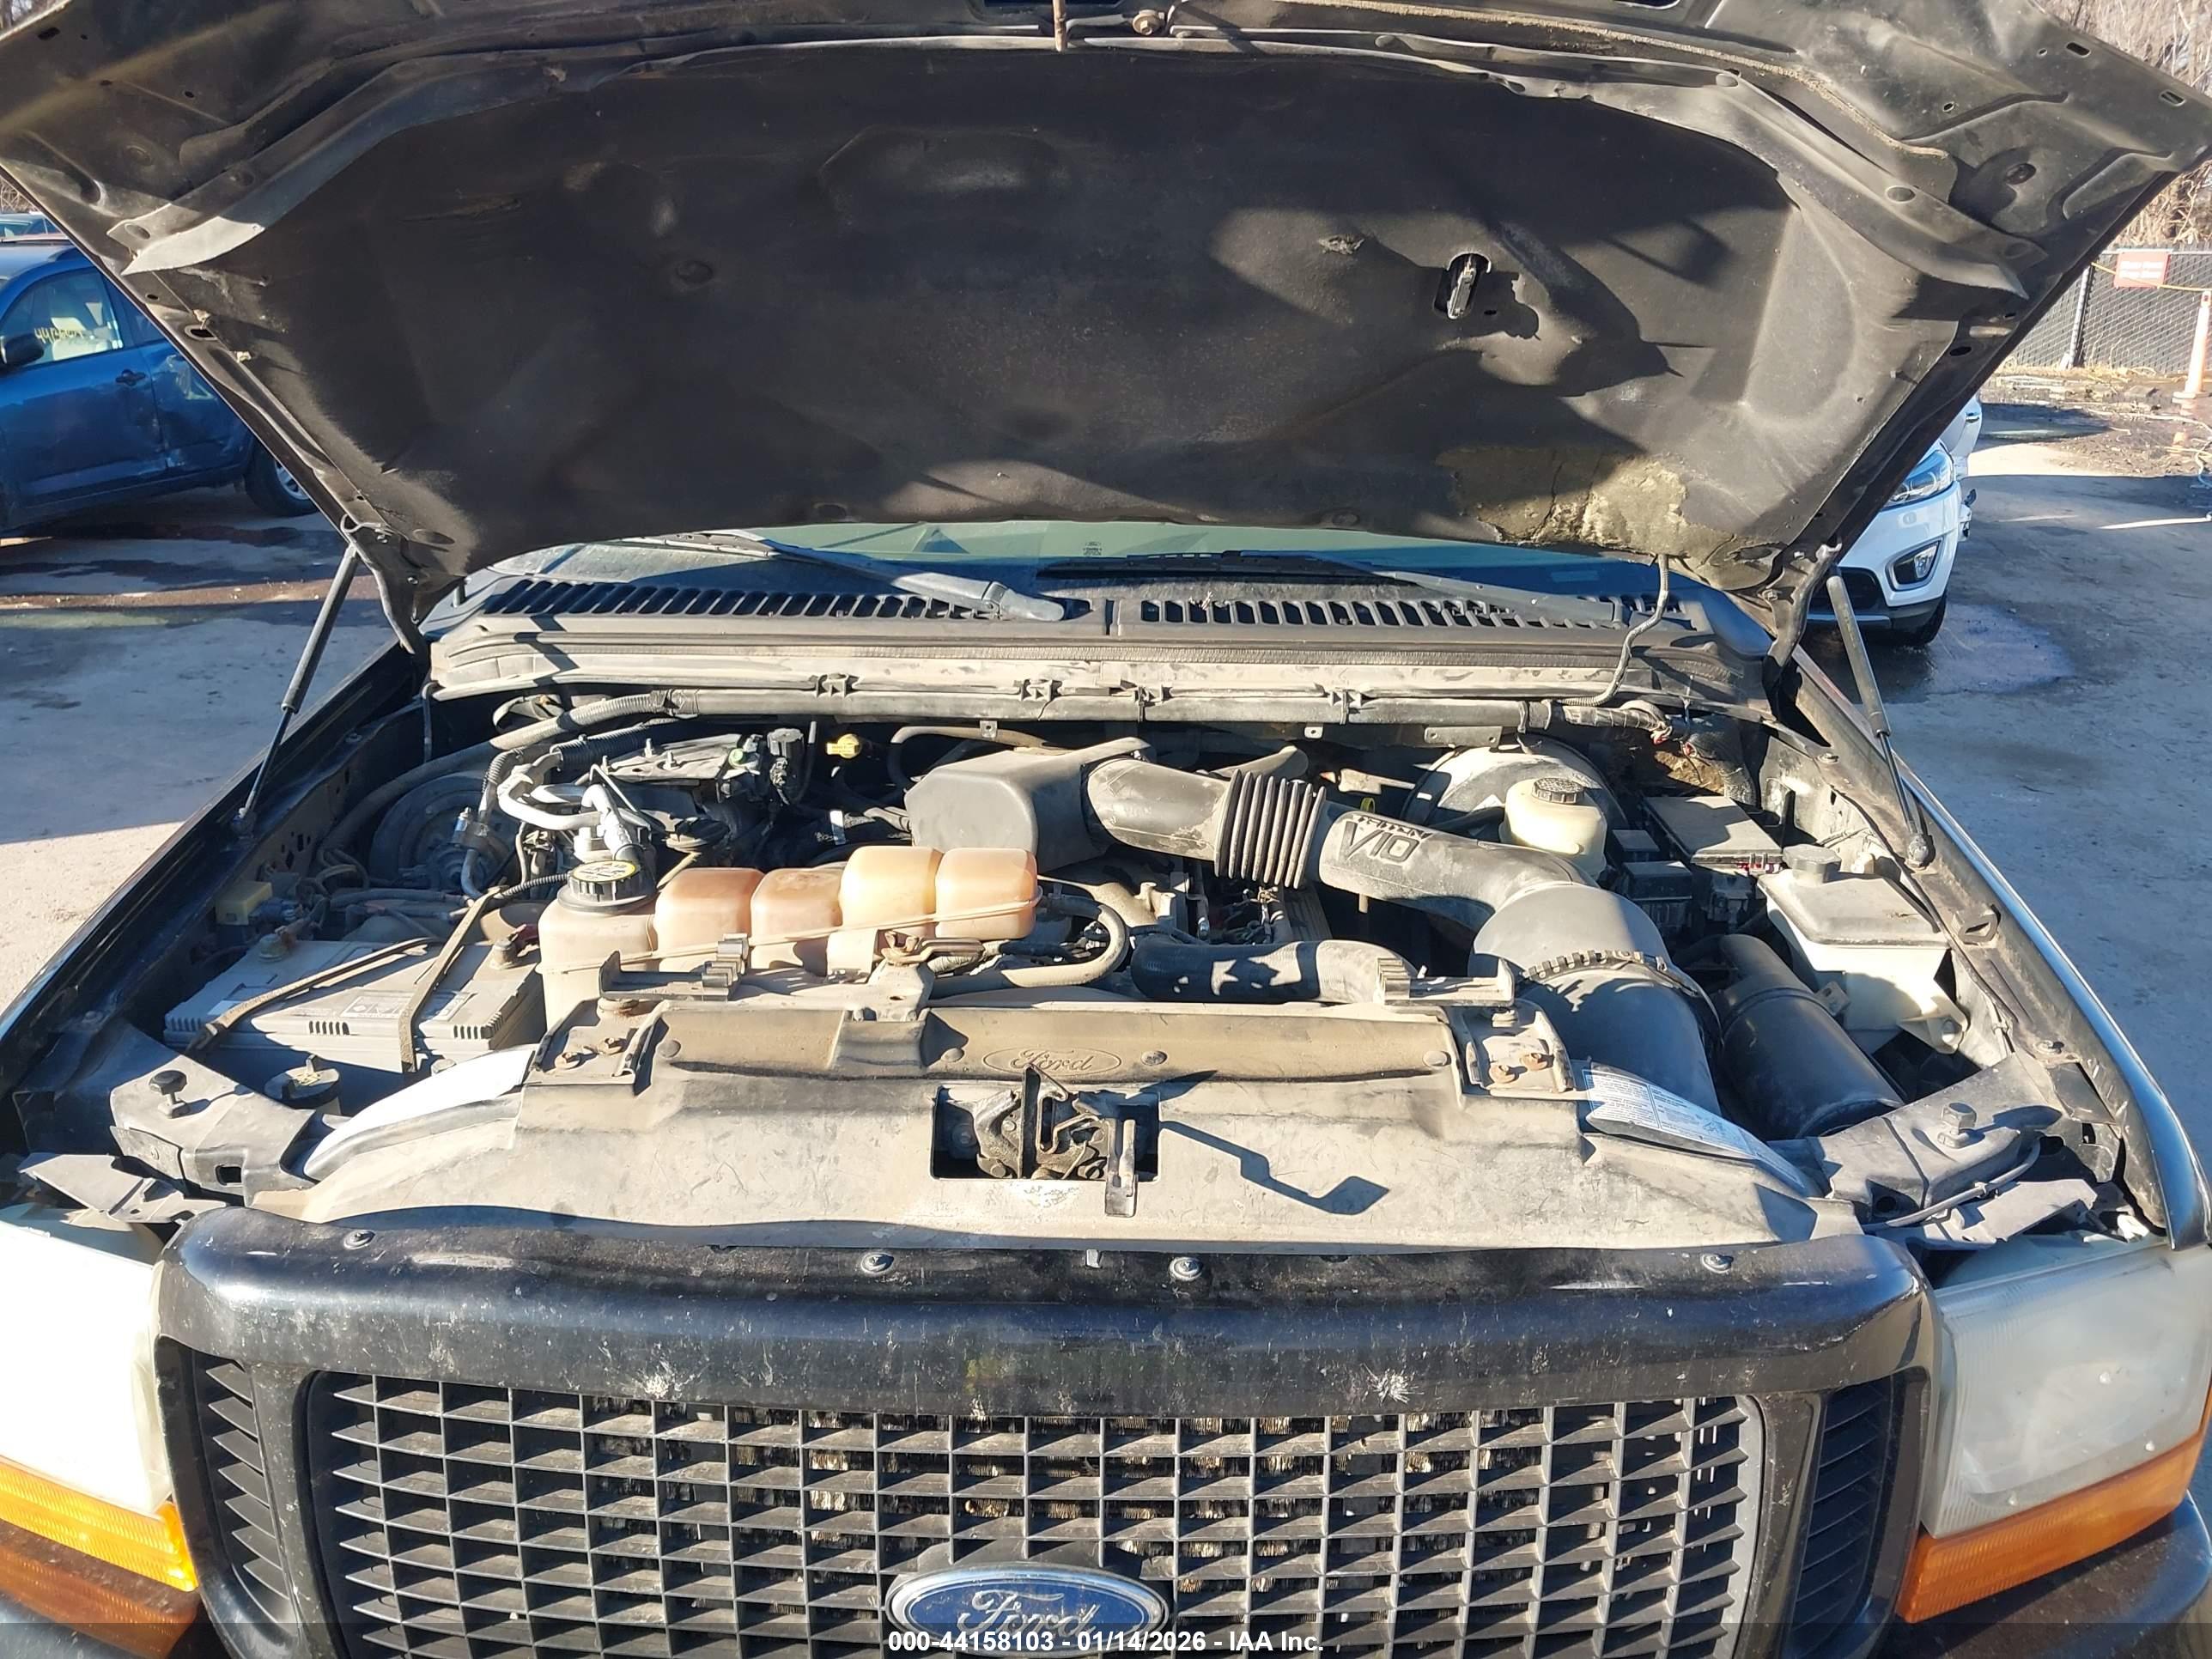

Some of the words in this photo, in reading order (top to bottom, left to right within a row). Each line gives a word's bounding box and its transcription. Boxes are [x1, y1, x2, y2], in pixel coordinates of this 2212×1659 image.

[1339, 819, 1420, 863] V10
[1010, 1048, 1094, 1072] Ford
[956, 1589, 1101, 1637] Ford
